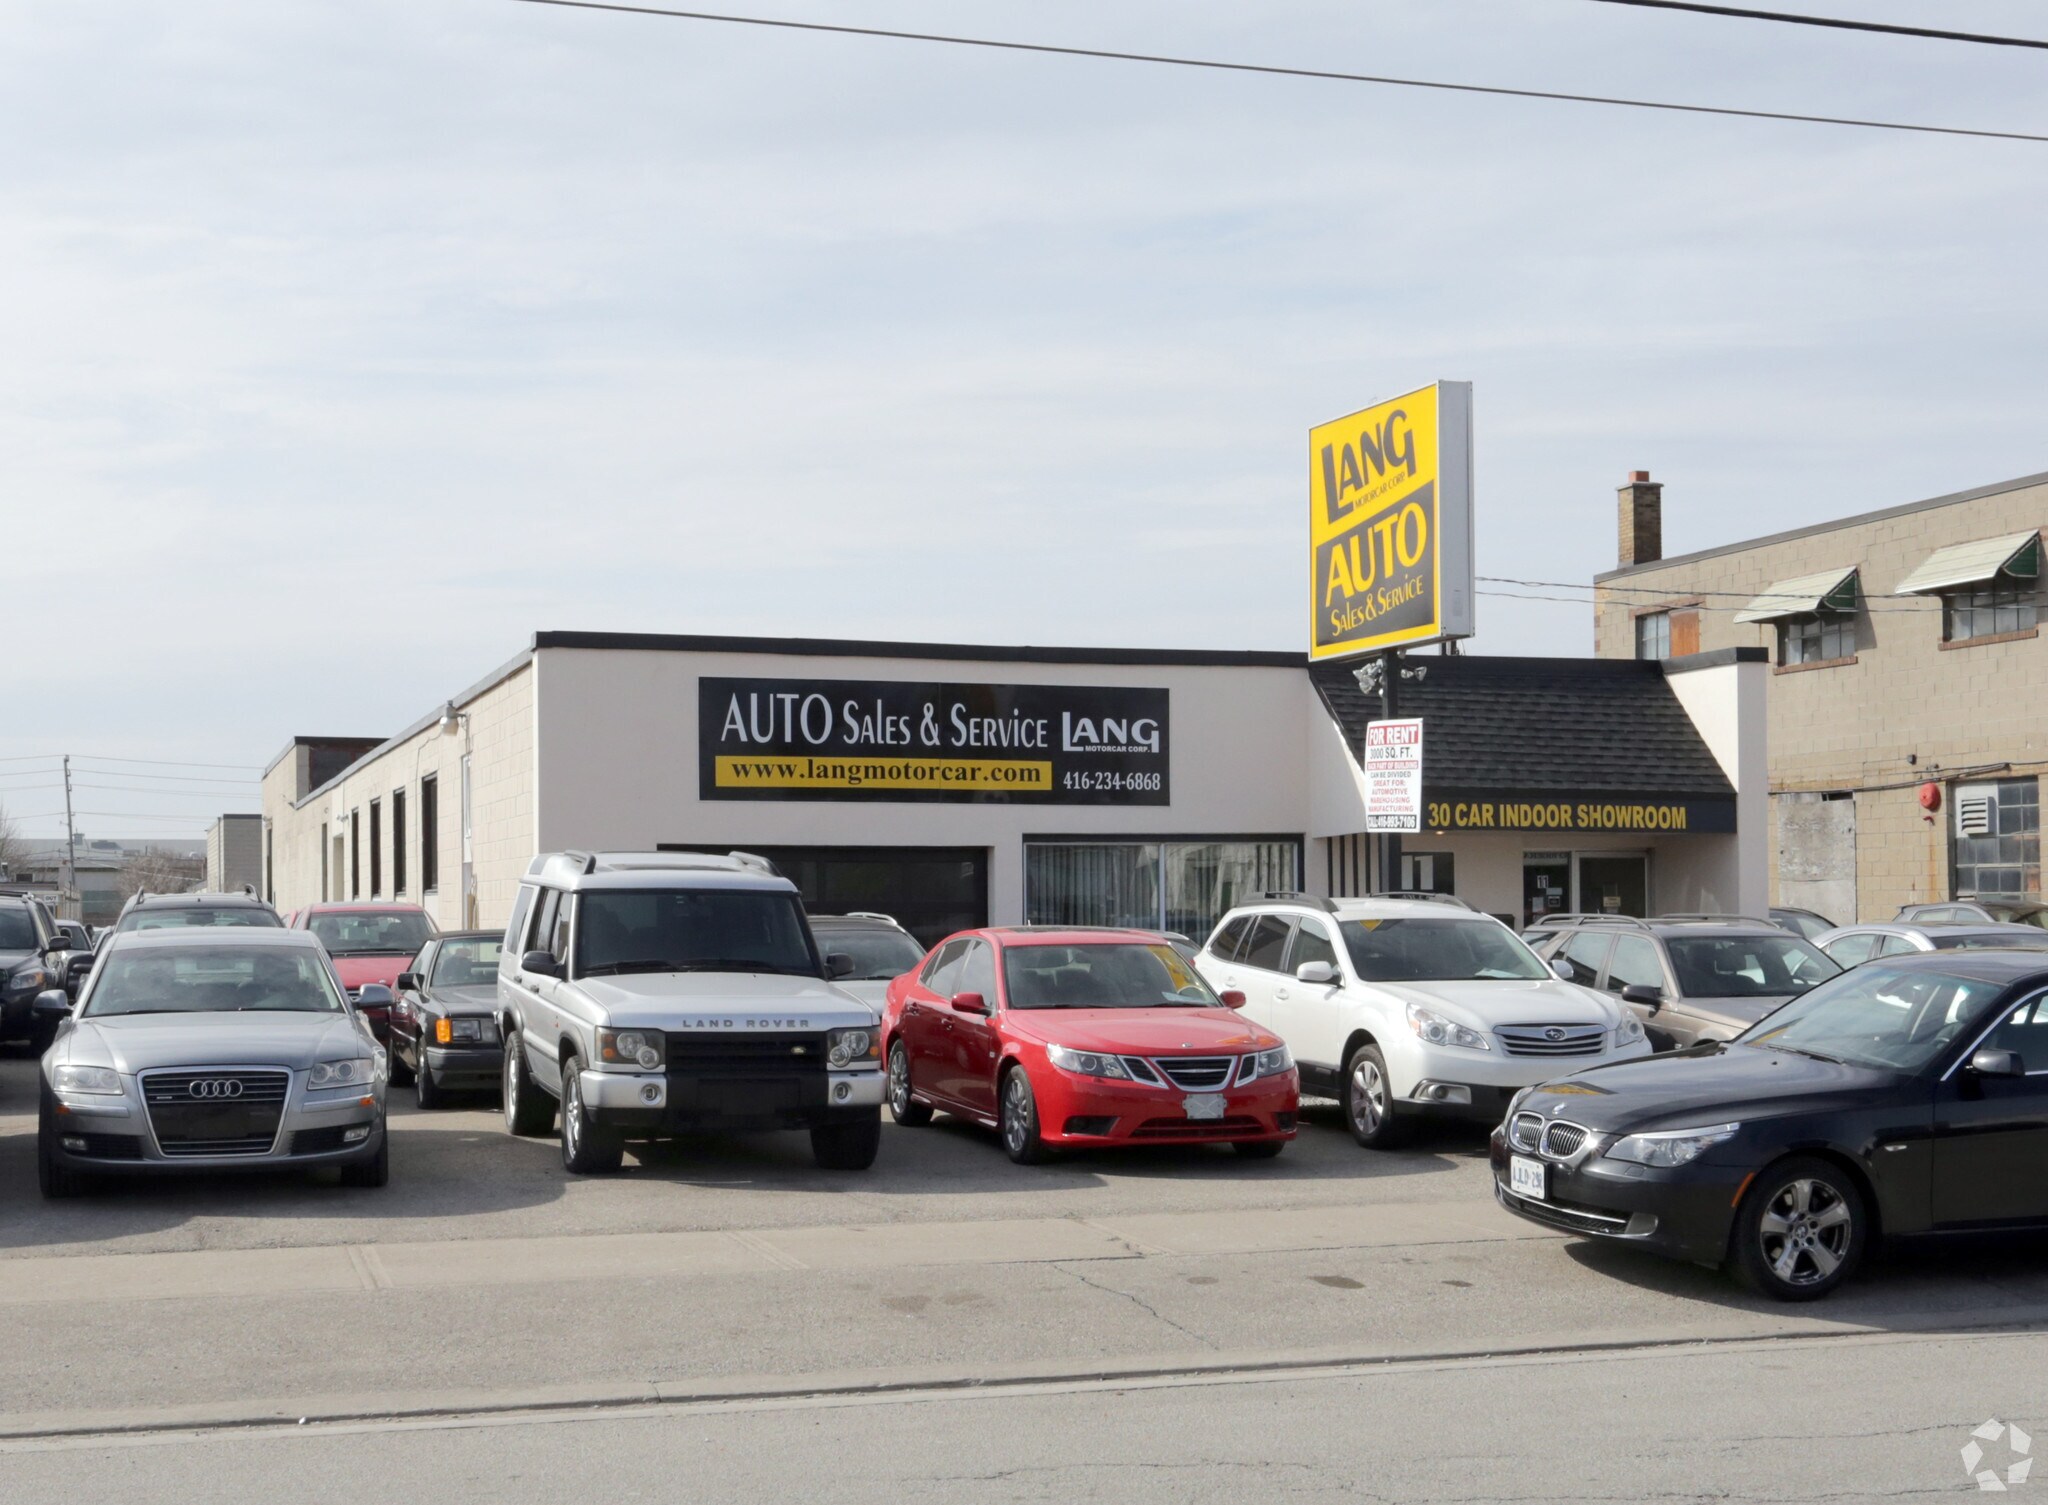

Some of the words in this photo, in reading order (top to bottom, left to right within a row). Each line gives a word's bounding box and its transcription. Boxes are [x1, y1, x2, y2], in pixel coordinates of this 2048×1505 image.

[1321, 409, 1417, 525] LANG
[1355, 482, 1388, 508] MOTORCAR
[1325, 502, 1427, 608] AUTO
[1365, 593, 1377, 621] &
[721, 693, 833, 745] AUTO
[920, 702, 941, 746] &
[1062, 711, 1160, 753] LANG
[1370, 727, 1385, 745] FOR
[1387, 725, 1418, 744] RENT
[1085, 745, 1127, 753] MOTORCAR
[1385, 747, 1399, 759] SQ.
[1400, 746, 1413, 758] FT.
[732, 758, 1041, 785] www.langmotorcar.com
[1063, 771, 1161, 791] 416-234-6868
[1387, 770, 1411, 778] DIVIDED
[1371, 787, 1408, 796] AUTOMOTIVE
[1428, 802, 1451, 827] 30
[1455, 803, 1495, 827] CAR
[1500, 803, 1573, 828] INDOOR
[1577, 804, 1687, 829] SHOWROOM
[682, 1019, 734, 1028] LAND
[746, 1019, 809, 1028] ROVER
